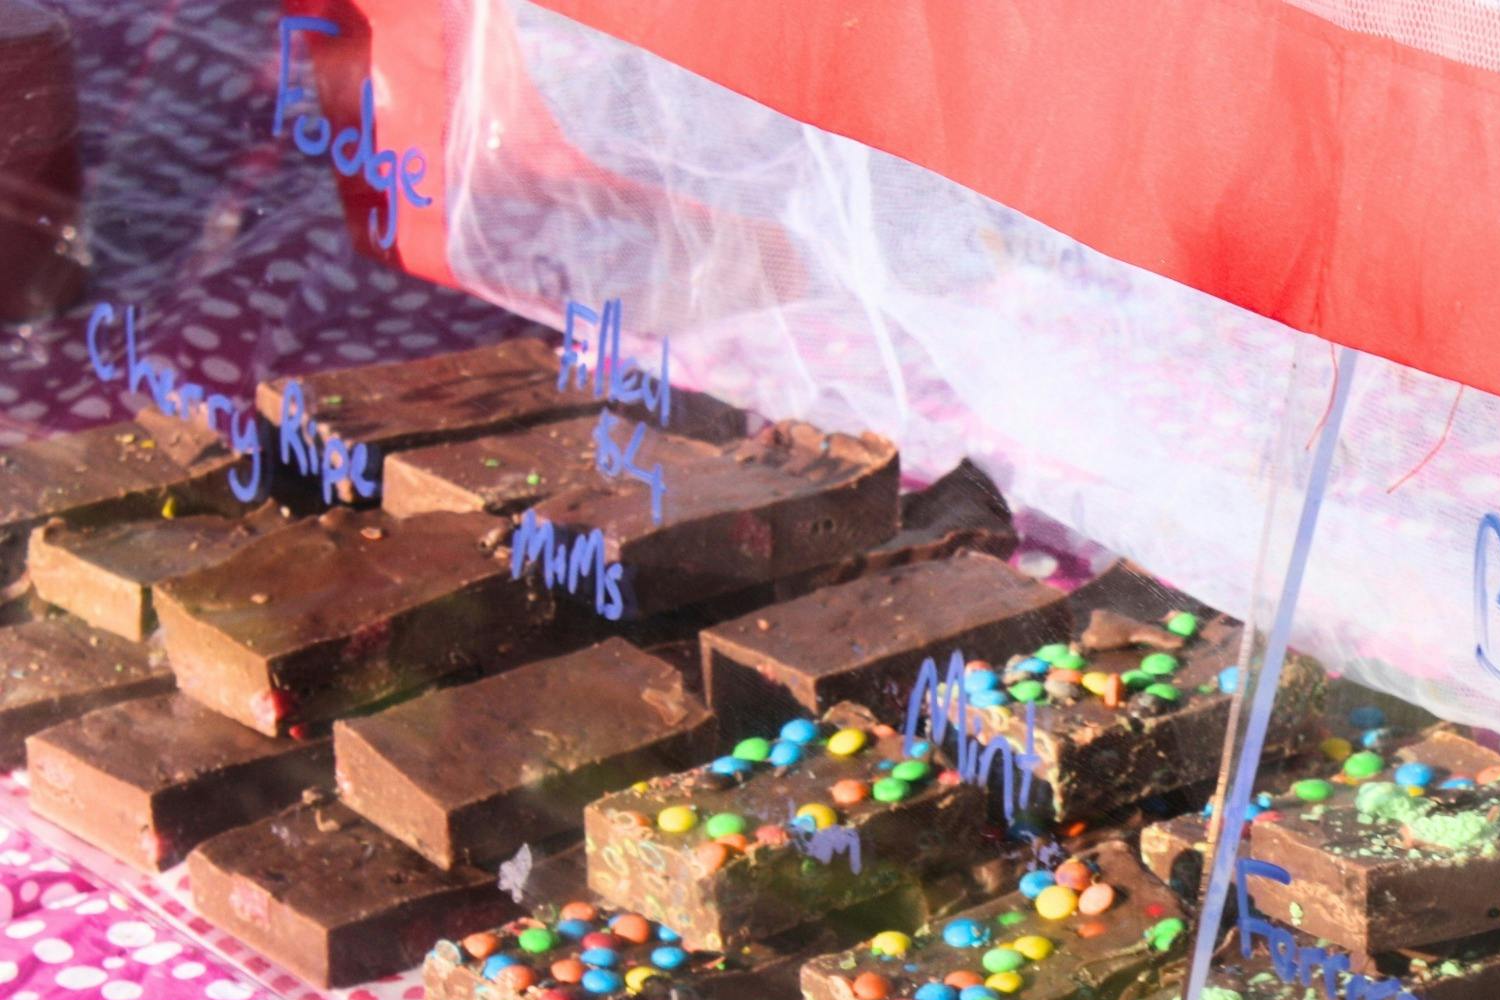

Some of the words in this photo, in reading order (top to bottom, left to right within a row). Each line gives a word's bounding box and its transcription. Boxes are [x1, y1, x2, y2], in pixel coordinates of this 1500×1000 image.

[86, 301, 262, 503] Cherry
[280, 379, 379, 506] Ripe
[557, 297, 669, 427] Filled
[904, 649, 1041, 828] Mint
